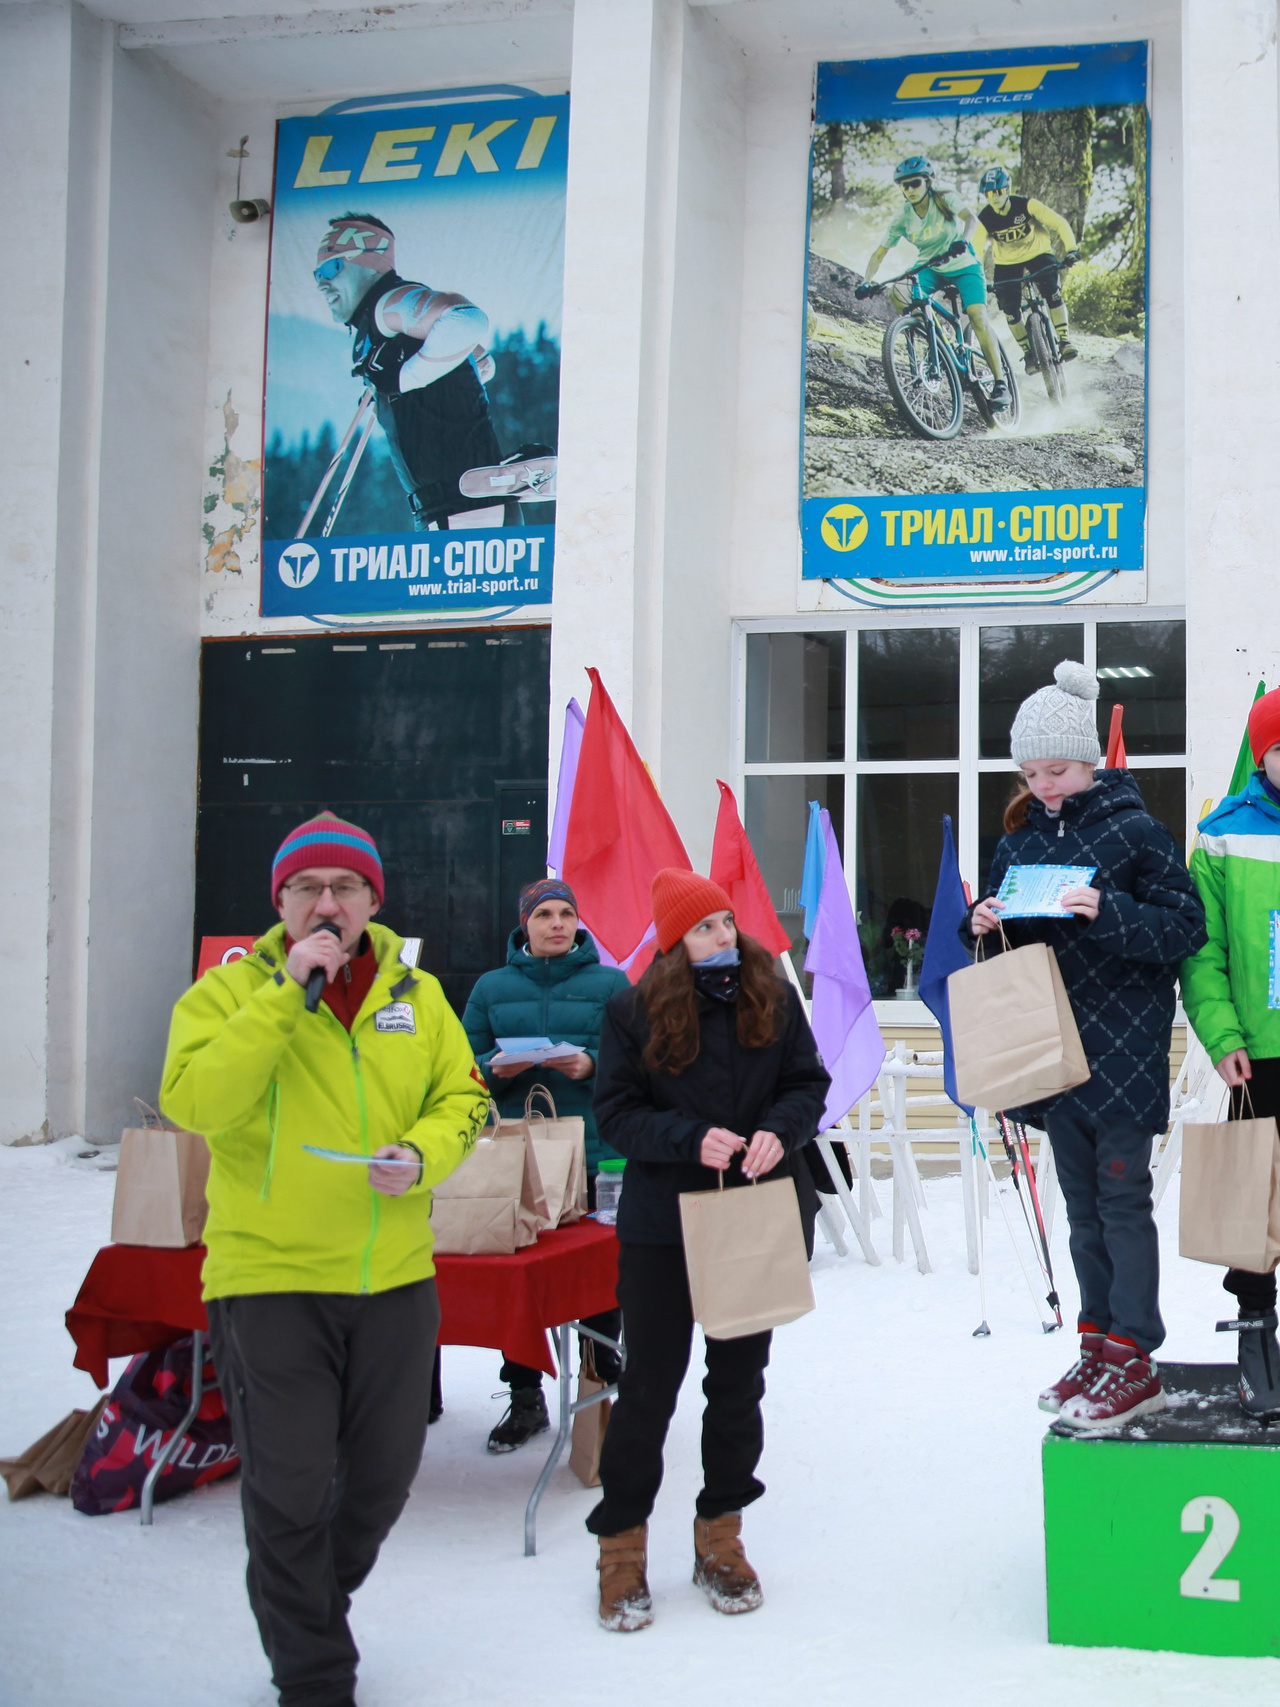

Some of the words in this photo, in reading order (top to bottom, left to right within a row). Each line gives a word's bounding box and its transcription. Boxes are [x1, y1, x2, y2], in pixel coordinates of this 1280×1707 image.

[896, 62, 1080, 99] GT
[959, 93, 1034, 105] BICYCLES
[293, 115, 557, 189] LEKI
[319, 228, 390, 255] EKI
[996, 225, 1026, 243] FOX
[970, 543, 1118, 564] www.trial-sport.ru
[409, 577, 539, 597] www.trial-sport.ru
[1228, 1319, 1264, 1329] SPINE
[1178, 1495, 1241, 1603] 2
